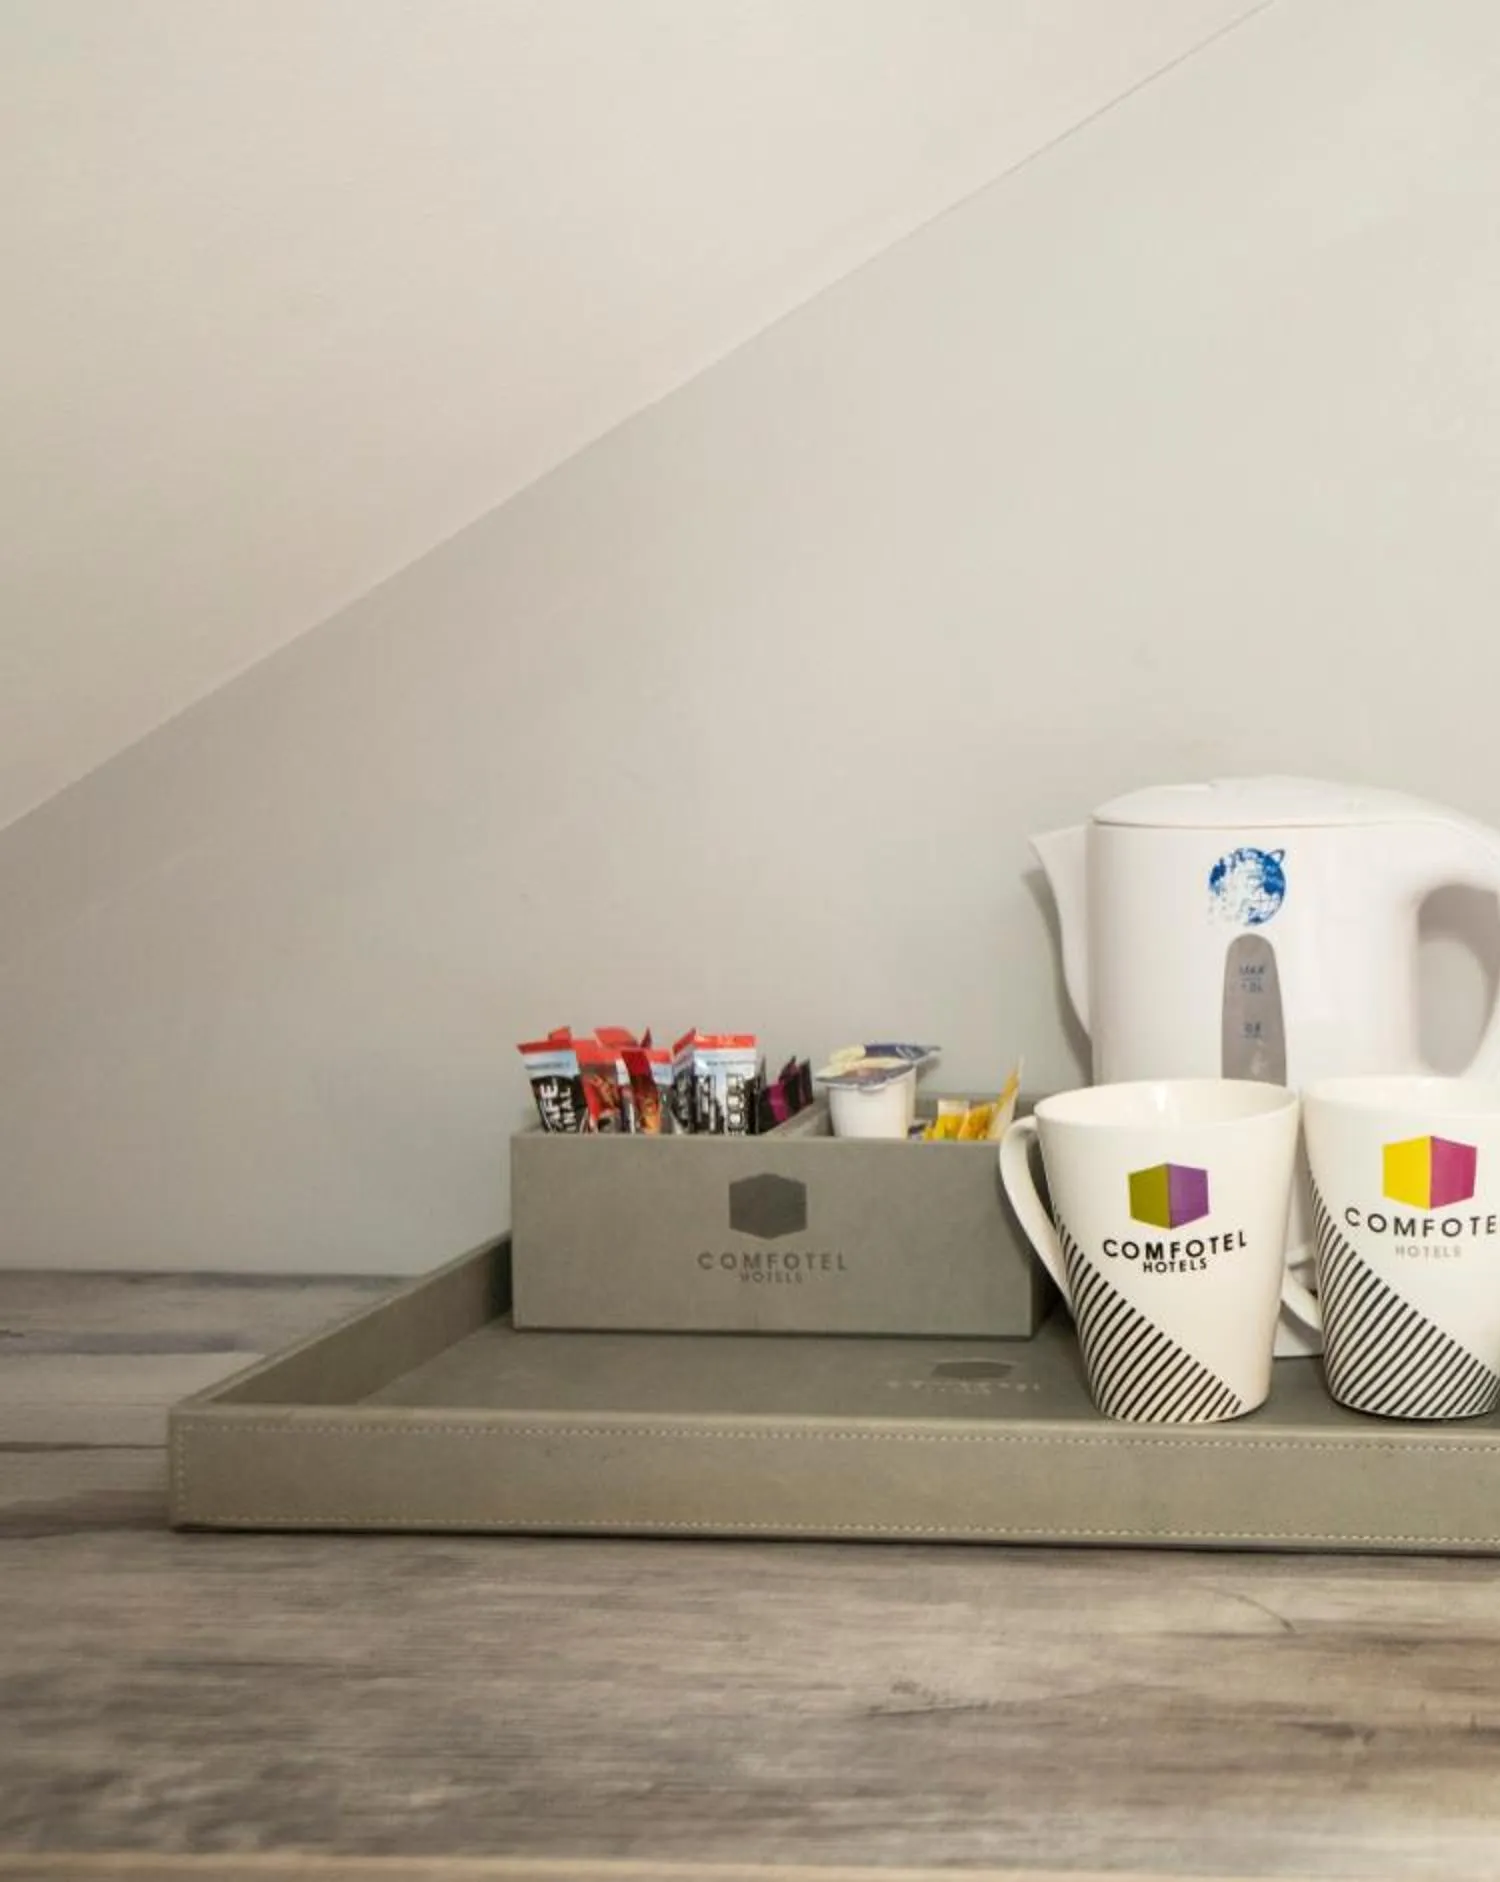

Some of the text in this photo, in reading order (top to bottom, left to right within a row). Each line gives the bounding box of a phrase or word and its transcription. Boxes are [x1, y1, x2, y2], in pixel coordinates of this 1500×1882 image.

[1102, 1230, 1247, 1260] COMFOTEL
[1395, 1245, 1461, 1259] HOTELS
[697, 1252, 848, 1271] COMFOTEL
[1143, 1258, 1207, 1273] HOTELS
